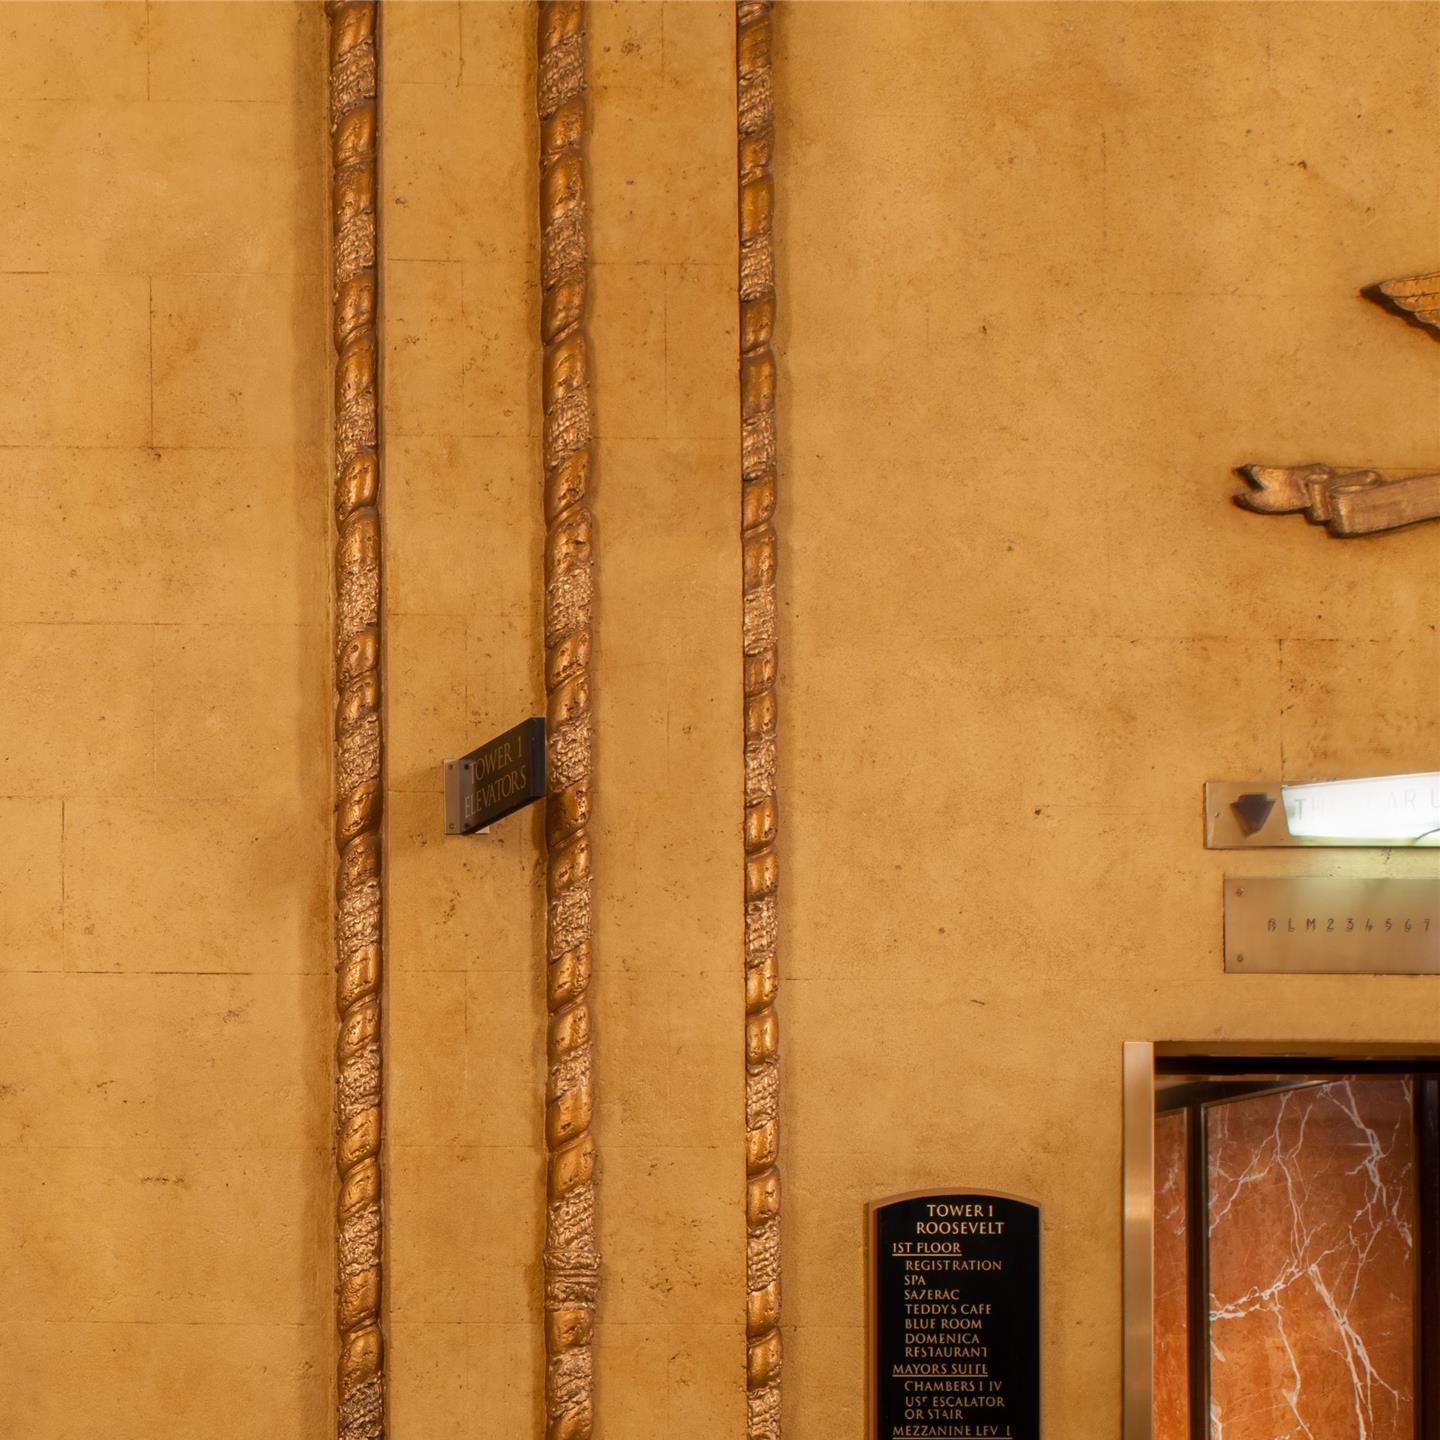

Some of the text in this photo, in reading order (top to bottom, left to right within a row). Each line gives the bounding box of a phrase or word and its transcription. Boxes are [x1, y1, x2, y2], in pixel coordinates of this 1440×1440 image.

[469, 742, 513, 784] TOWER
[464, 764, 527, 818] ELEVATORS
[1268, 918, 1431, 932] B L M 2 3 4 5 6 7
[927, 1204, 984, 1217] TOWER
[916, 1221, 1005, 1234] ROOSEVELT
[892, 1242, 961, 1253] 1ST FLOOR
[906, 1260, 1002, 1271] REGISTRATION
[904, 1275, 926, 1285] SPA
[904, 1290, 960, 1300] SAZERAC
[905, 1304, 957, 1315] TEDDYS
[905, 1319, 982, 1330] BLUE ROOM
[905, 1333, 980, 1344] DOMENICA
[905, 1347, 988, 1358] RESTAURANT
[951, 1364, 988, 1375] SUITE
[904, 1381, 975, 1392] CHAMBERS
[932, 1396, 1005, 1407] ESCALATOR
[904, 1409, 963, 1420] OR STAIR
[892, 1425, 1011, 1436] MEZZANINE LEVL
